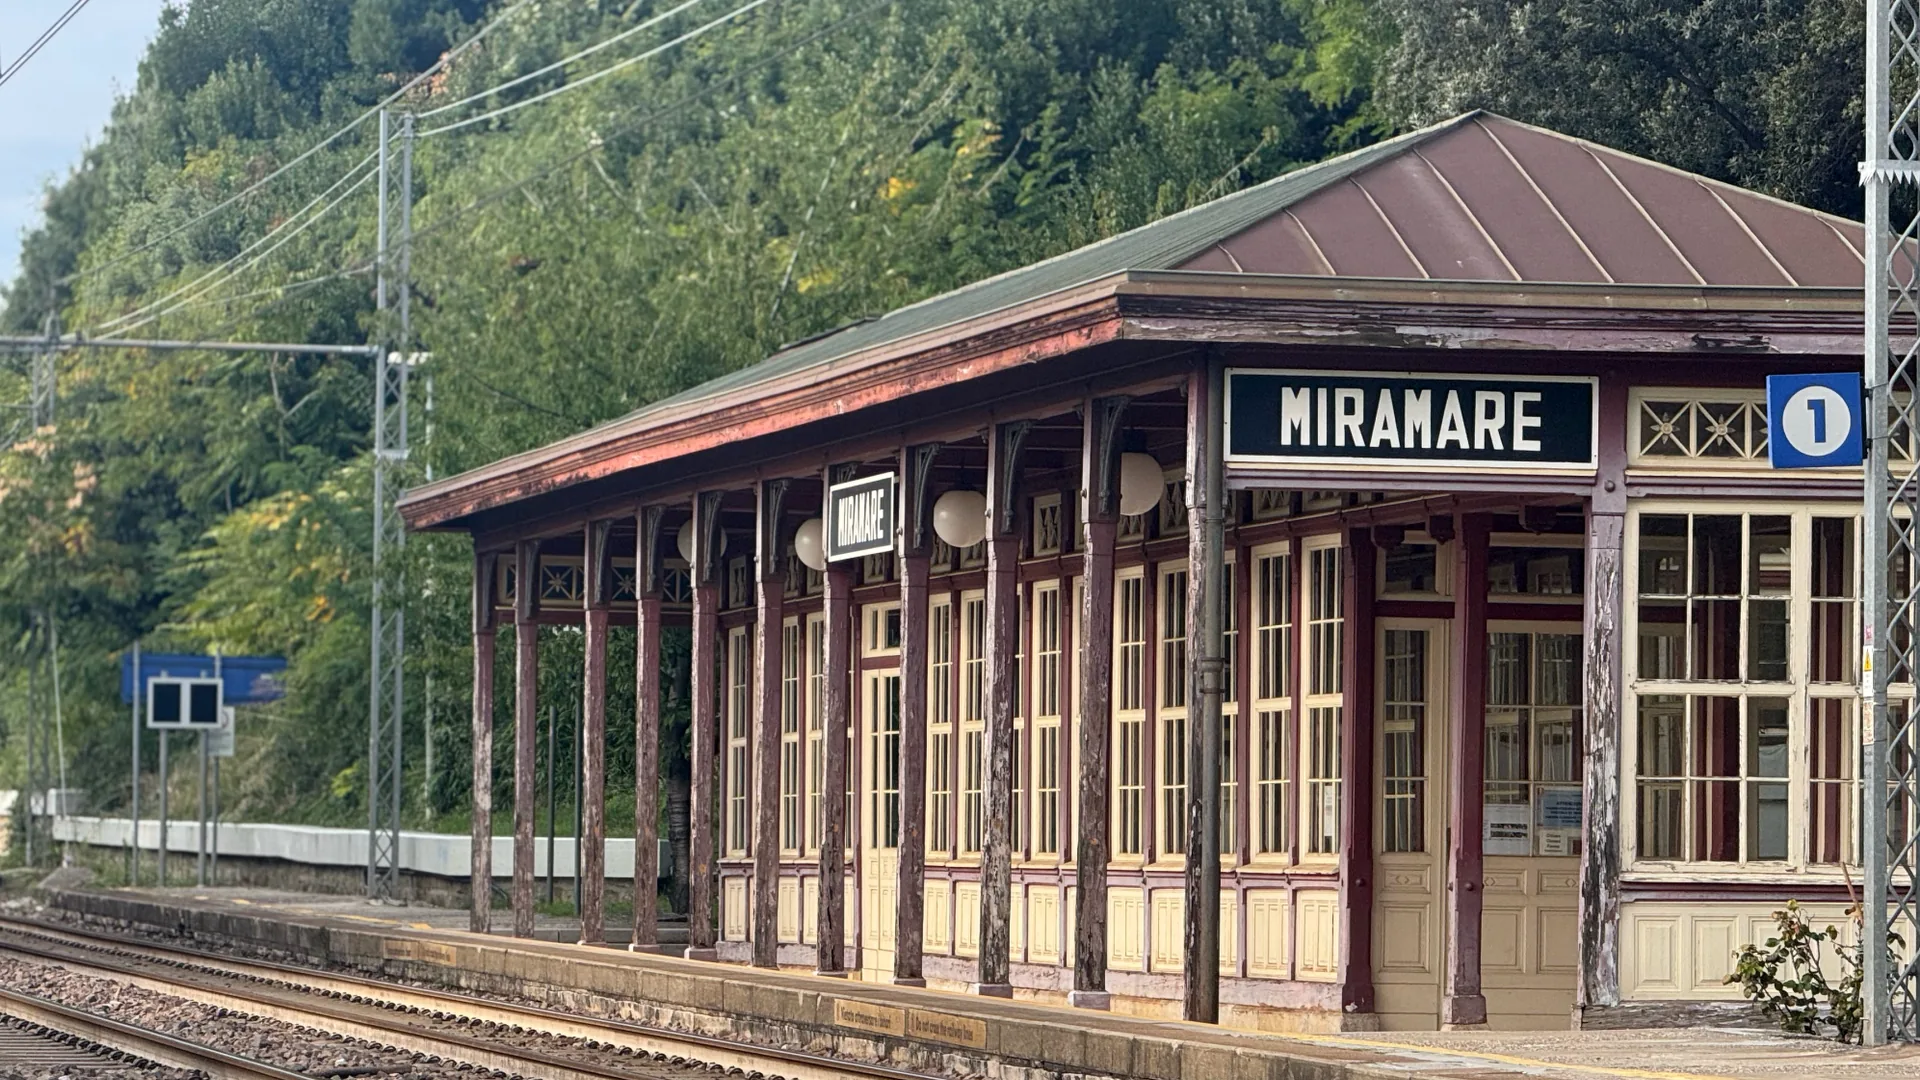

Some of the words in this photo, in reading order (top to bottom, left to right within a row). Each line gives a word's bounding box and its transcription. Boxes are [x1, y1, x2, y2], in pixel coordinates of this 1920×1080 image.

[1281, 387, 1542, 452] MIRAMARE
[1807, 398, 1826, 443] 1
[838, 488, 884, 547] MIRAMARE
